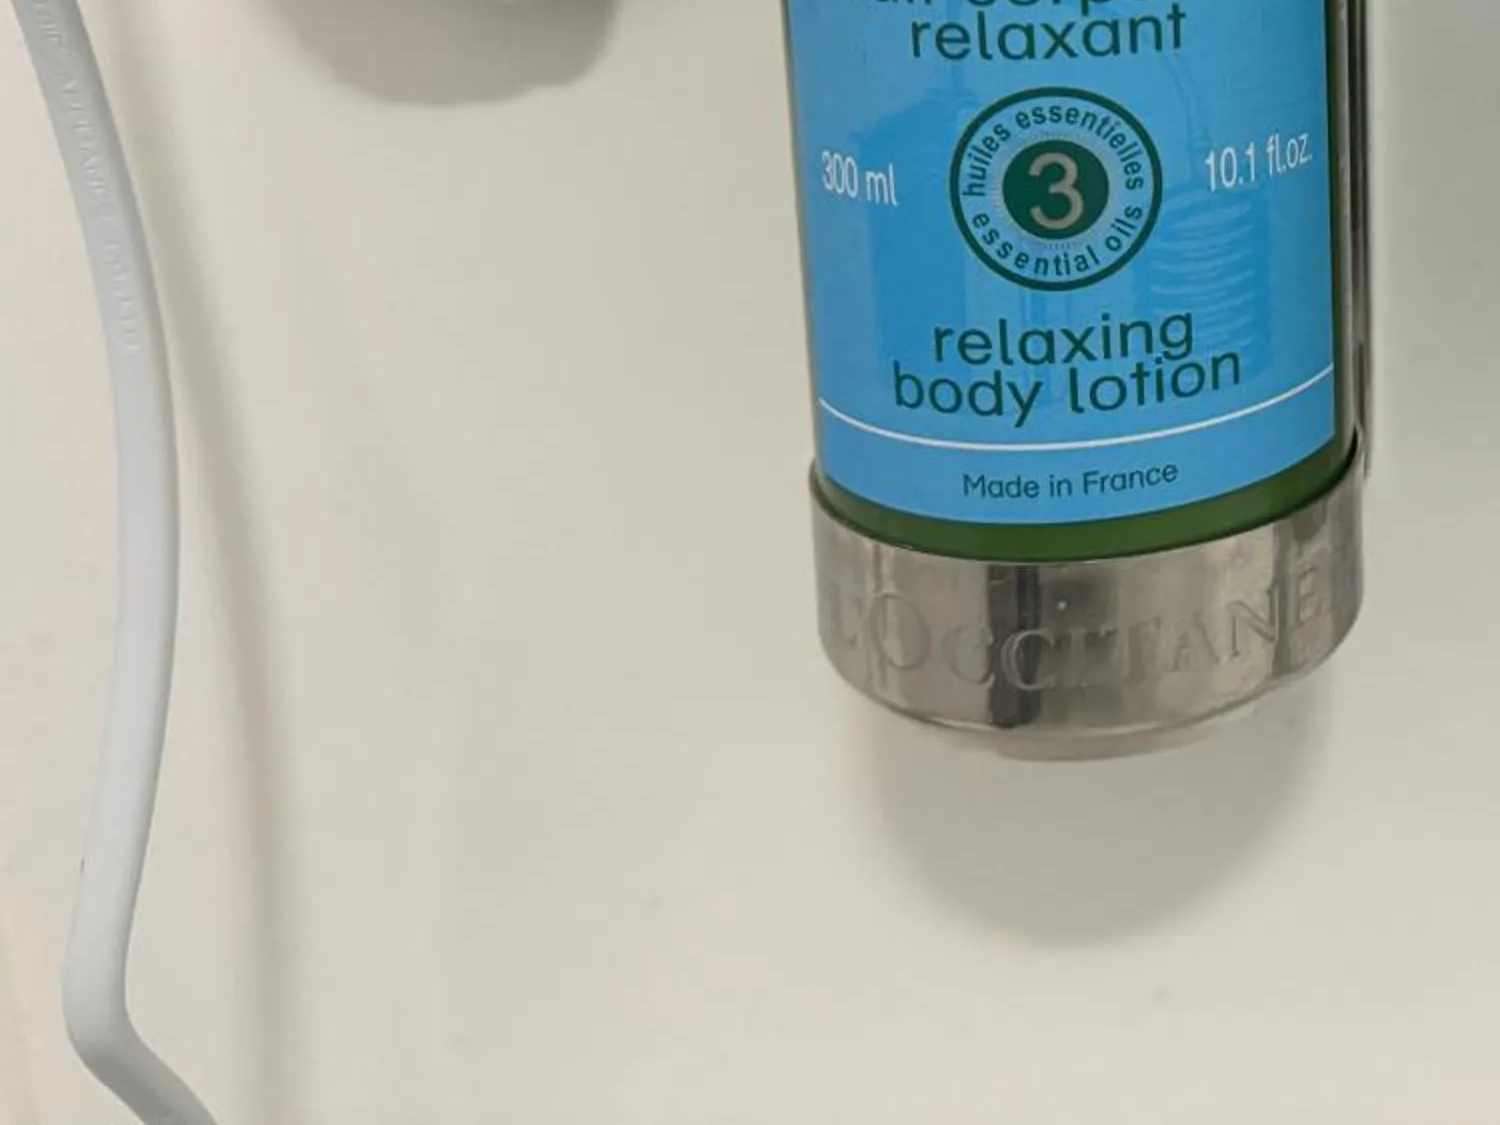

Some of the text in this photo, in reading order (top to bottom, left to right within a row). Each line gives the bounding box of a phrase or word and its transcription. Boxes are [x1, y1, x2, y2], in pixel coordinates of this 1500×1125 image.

[911, 3, 1188, 61] relaxant
[820, 148, 898, 206] 300 ml
[962, 105, 1145, 197] huiles essentielles
[1205, 144, 1257, 194] 10.1
[1028, 152, 1084, 230] 3
[972, 205, 1144, 276] essential oils
[933, 311, 1194, 366] relaxing
[893, 349, 1242, 429] body lotion
[962, 462, 1179, 500] Made in France
